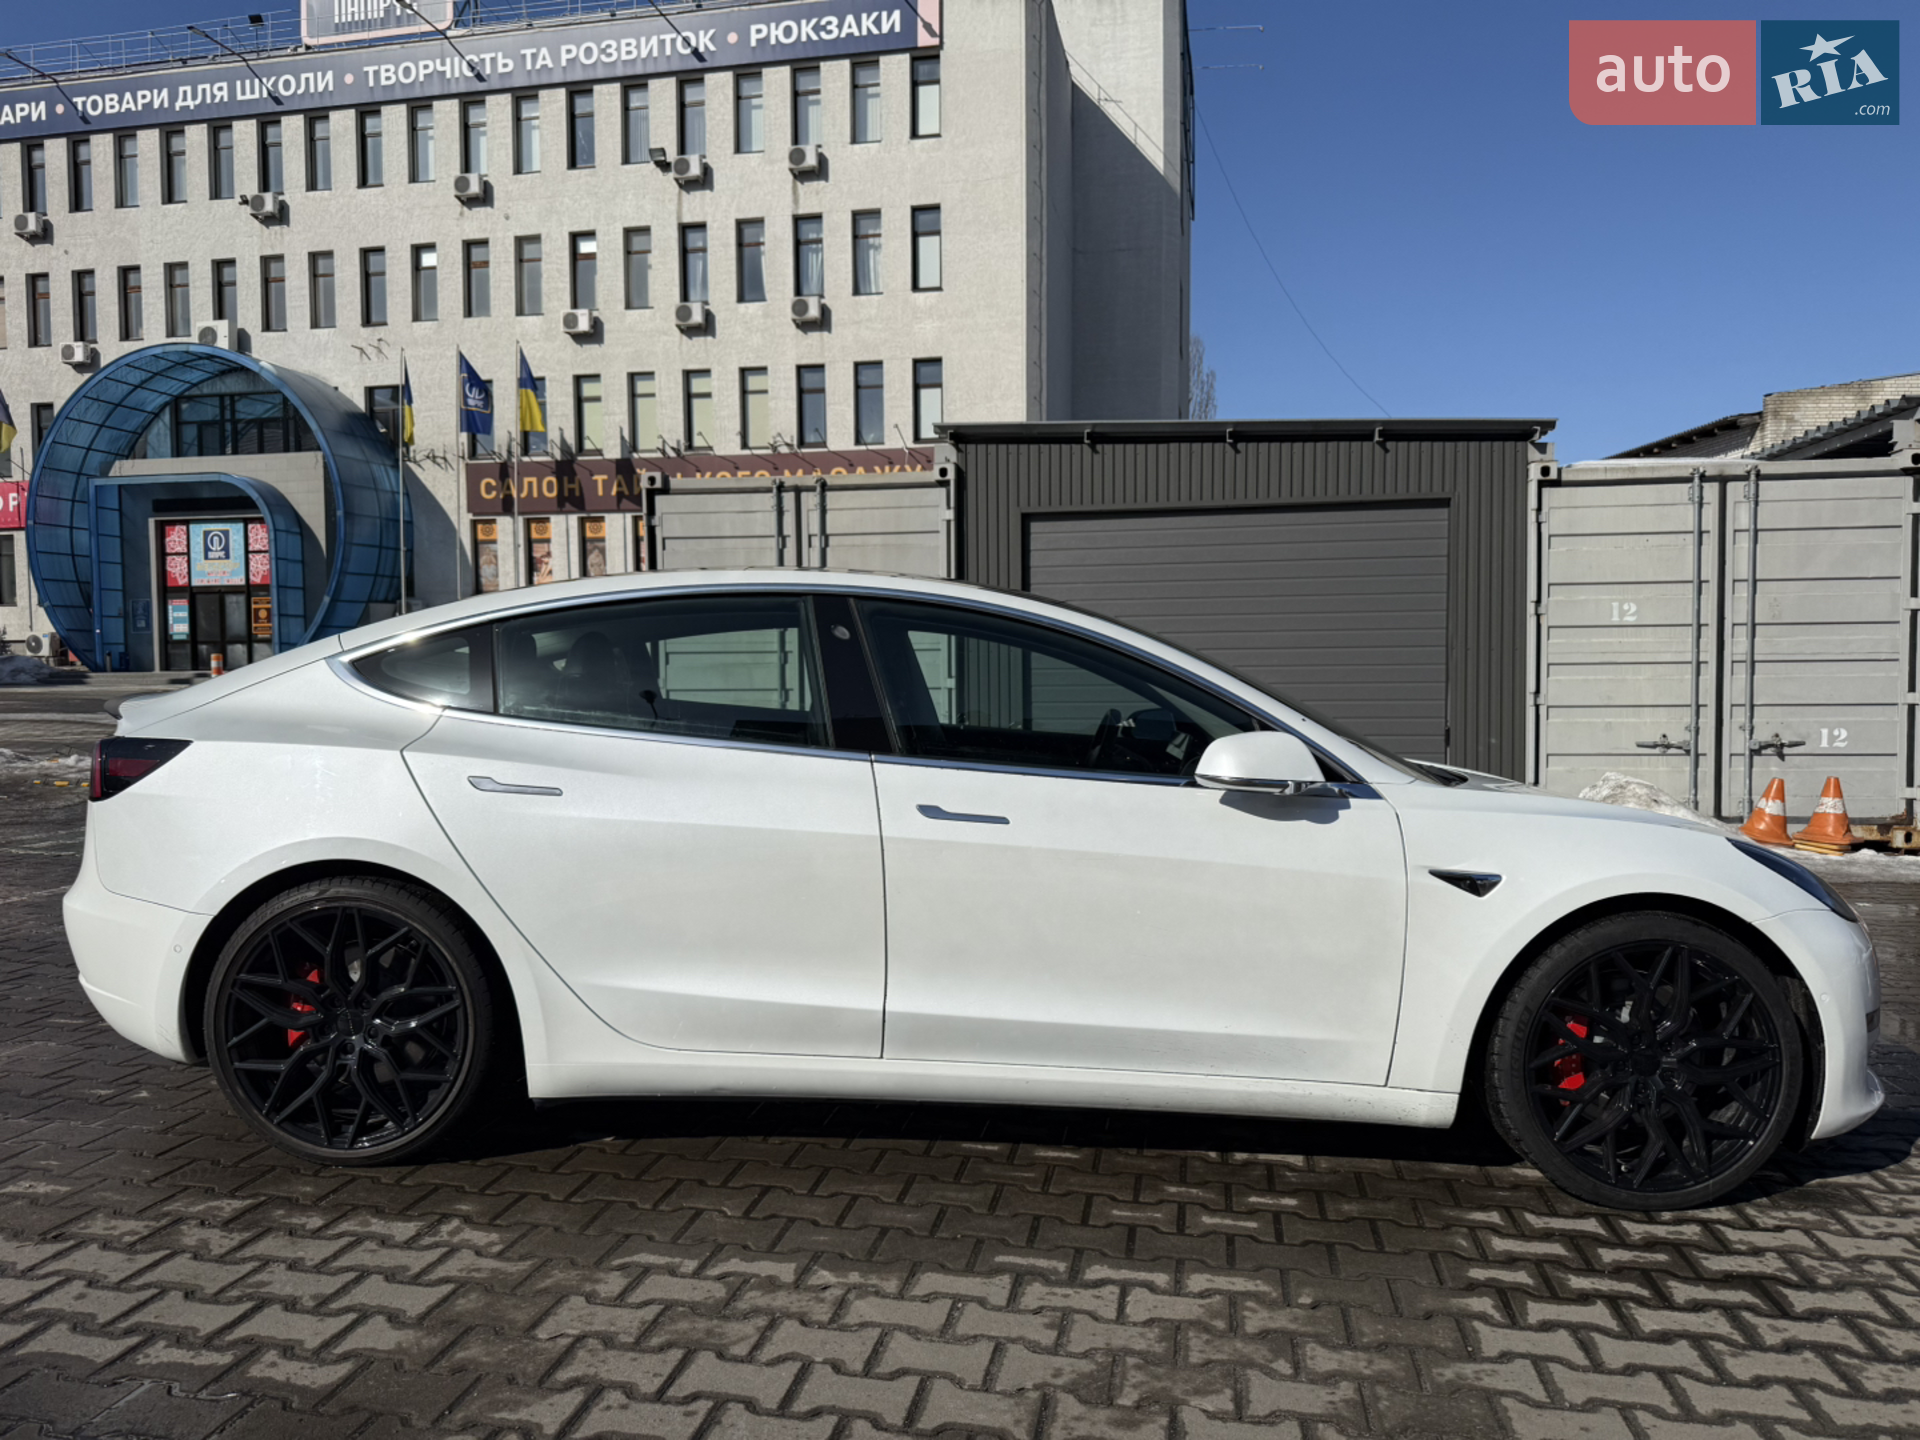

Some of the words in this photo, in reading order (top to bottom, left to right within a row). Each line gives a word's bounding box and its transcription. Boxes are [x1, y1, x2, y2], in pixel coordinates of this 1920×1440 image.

[72, 88, 168, 117] ТОВАРИ
[174, 82, 228, 111] ДЛЯ
[235, 71, 334, 101] ШКОЛИ
[363, 51, 514, 88] ТВОРЧІСТЬ
[520, 47, 554, 70] ТА
[560, 28, 717, 67] РОЗВИТОК
[750, 9, 901, 46] РЮКЗАКИ
[479, 475, 580, 500] САЛОН
[1610, 602, 1638, 622] 12
[1819, 728, 1848, 748] 12
